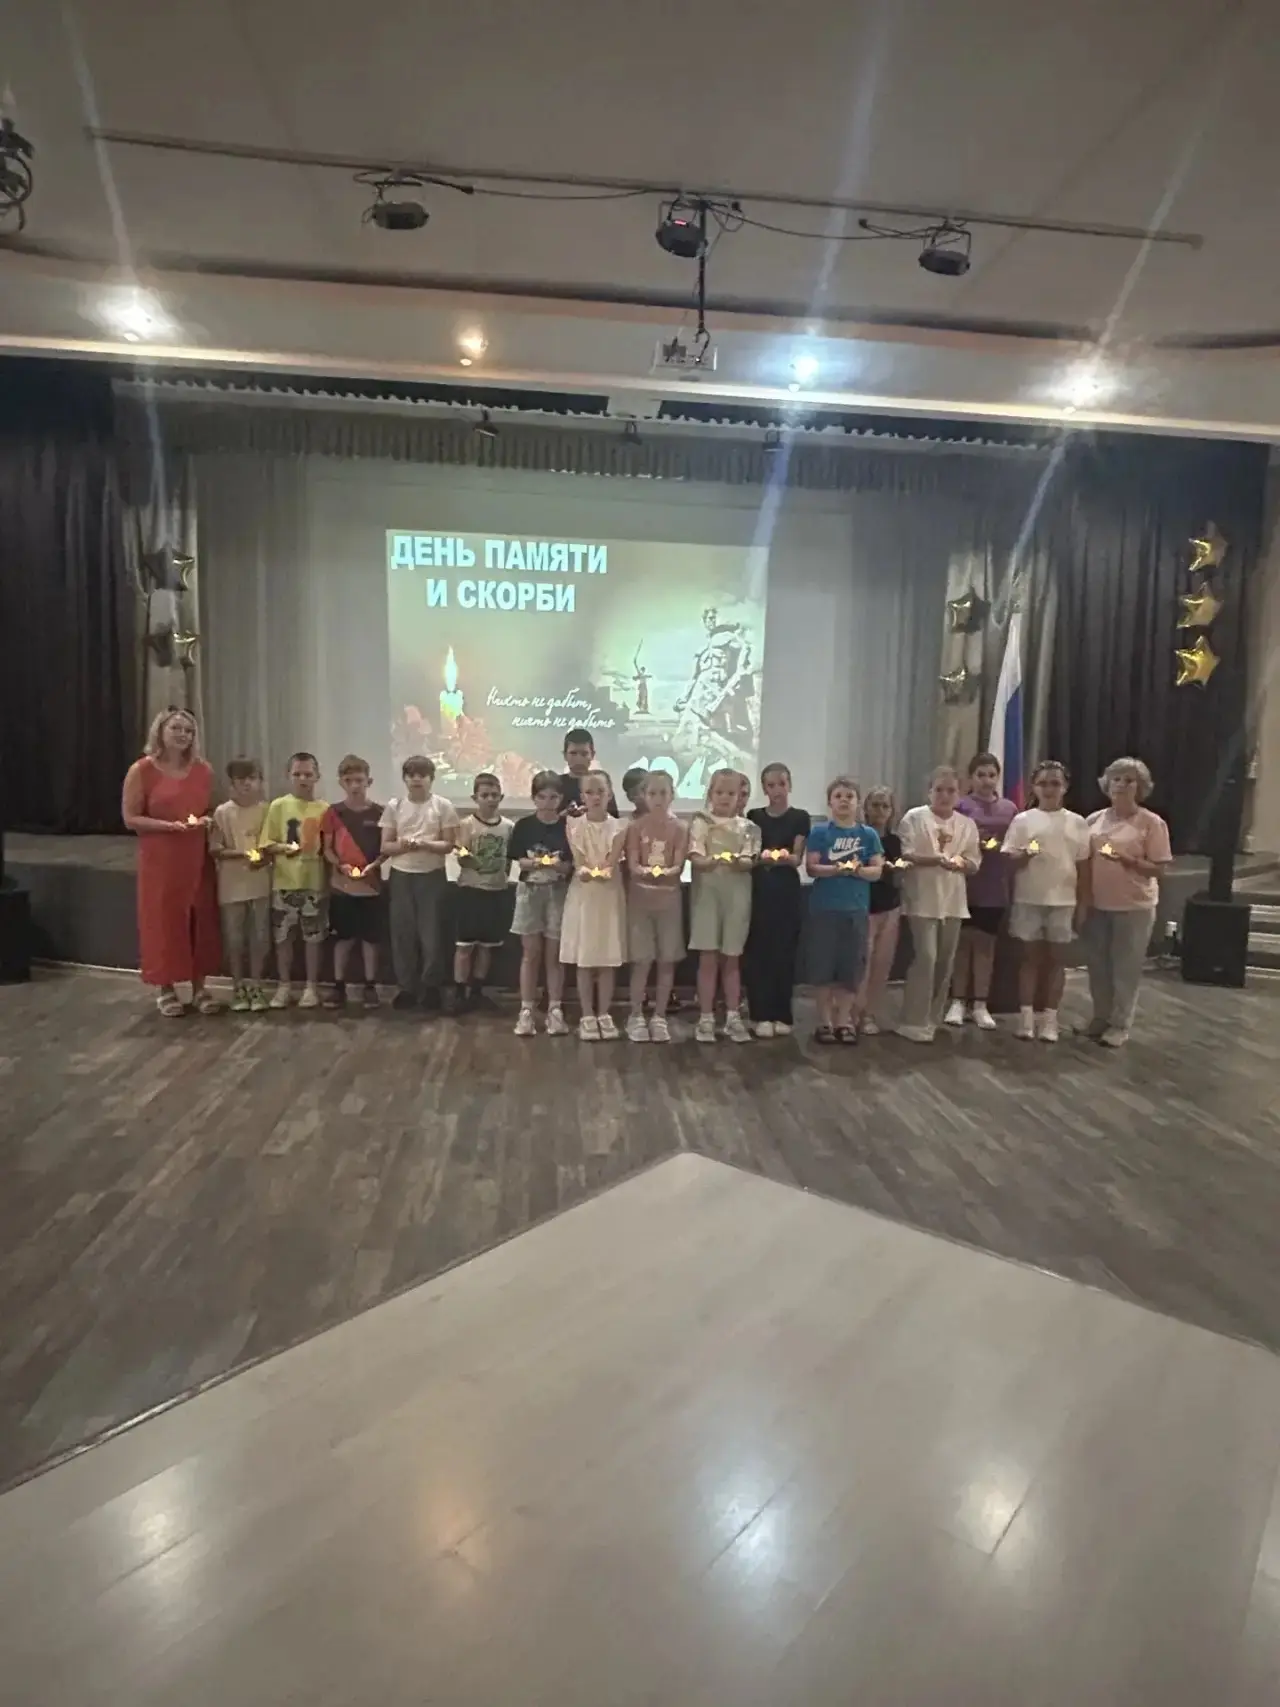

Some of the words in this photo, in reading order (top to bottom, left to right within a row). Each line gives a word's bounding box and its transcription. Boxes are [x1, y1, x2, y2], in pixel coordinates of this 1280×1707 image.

[391, 535, 476, 570] ДЕНЬ
[484, 539, 608, 574] ПАМЯТИ
[426, 578, 448, 608] И
[456, 579, 576, 613] СКОРБИ
